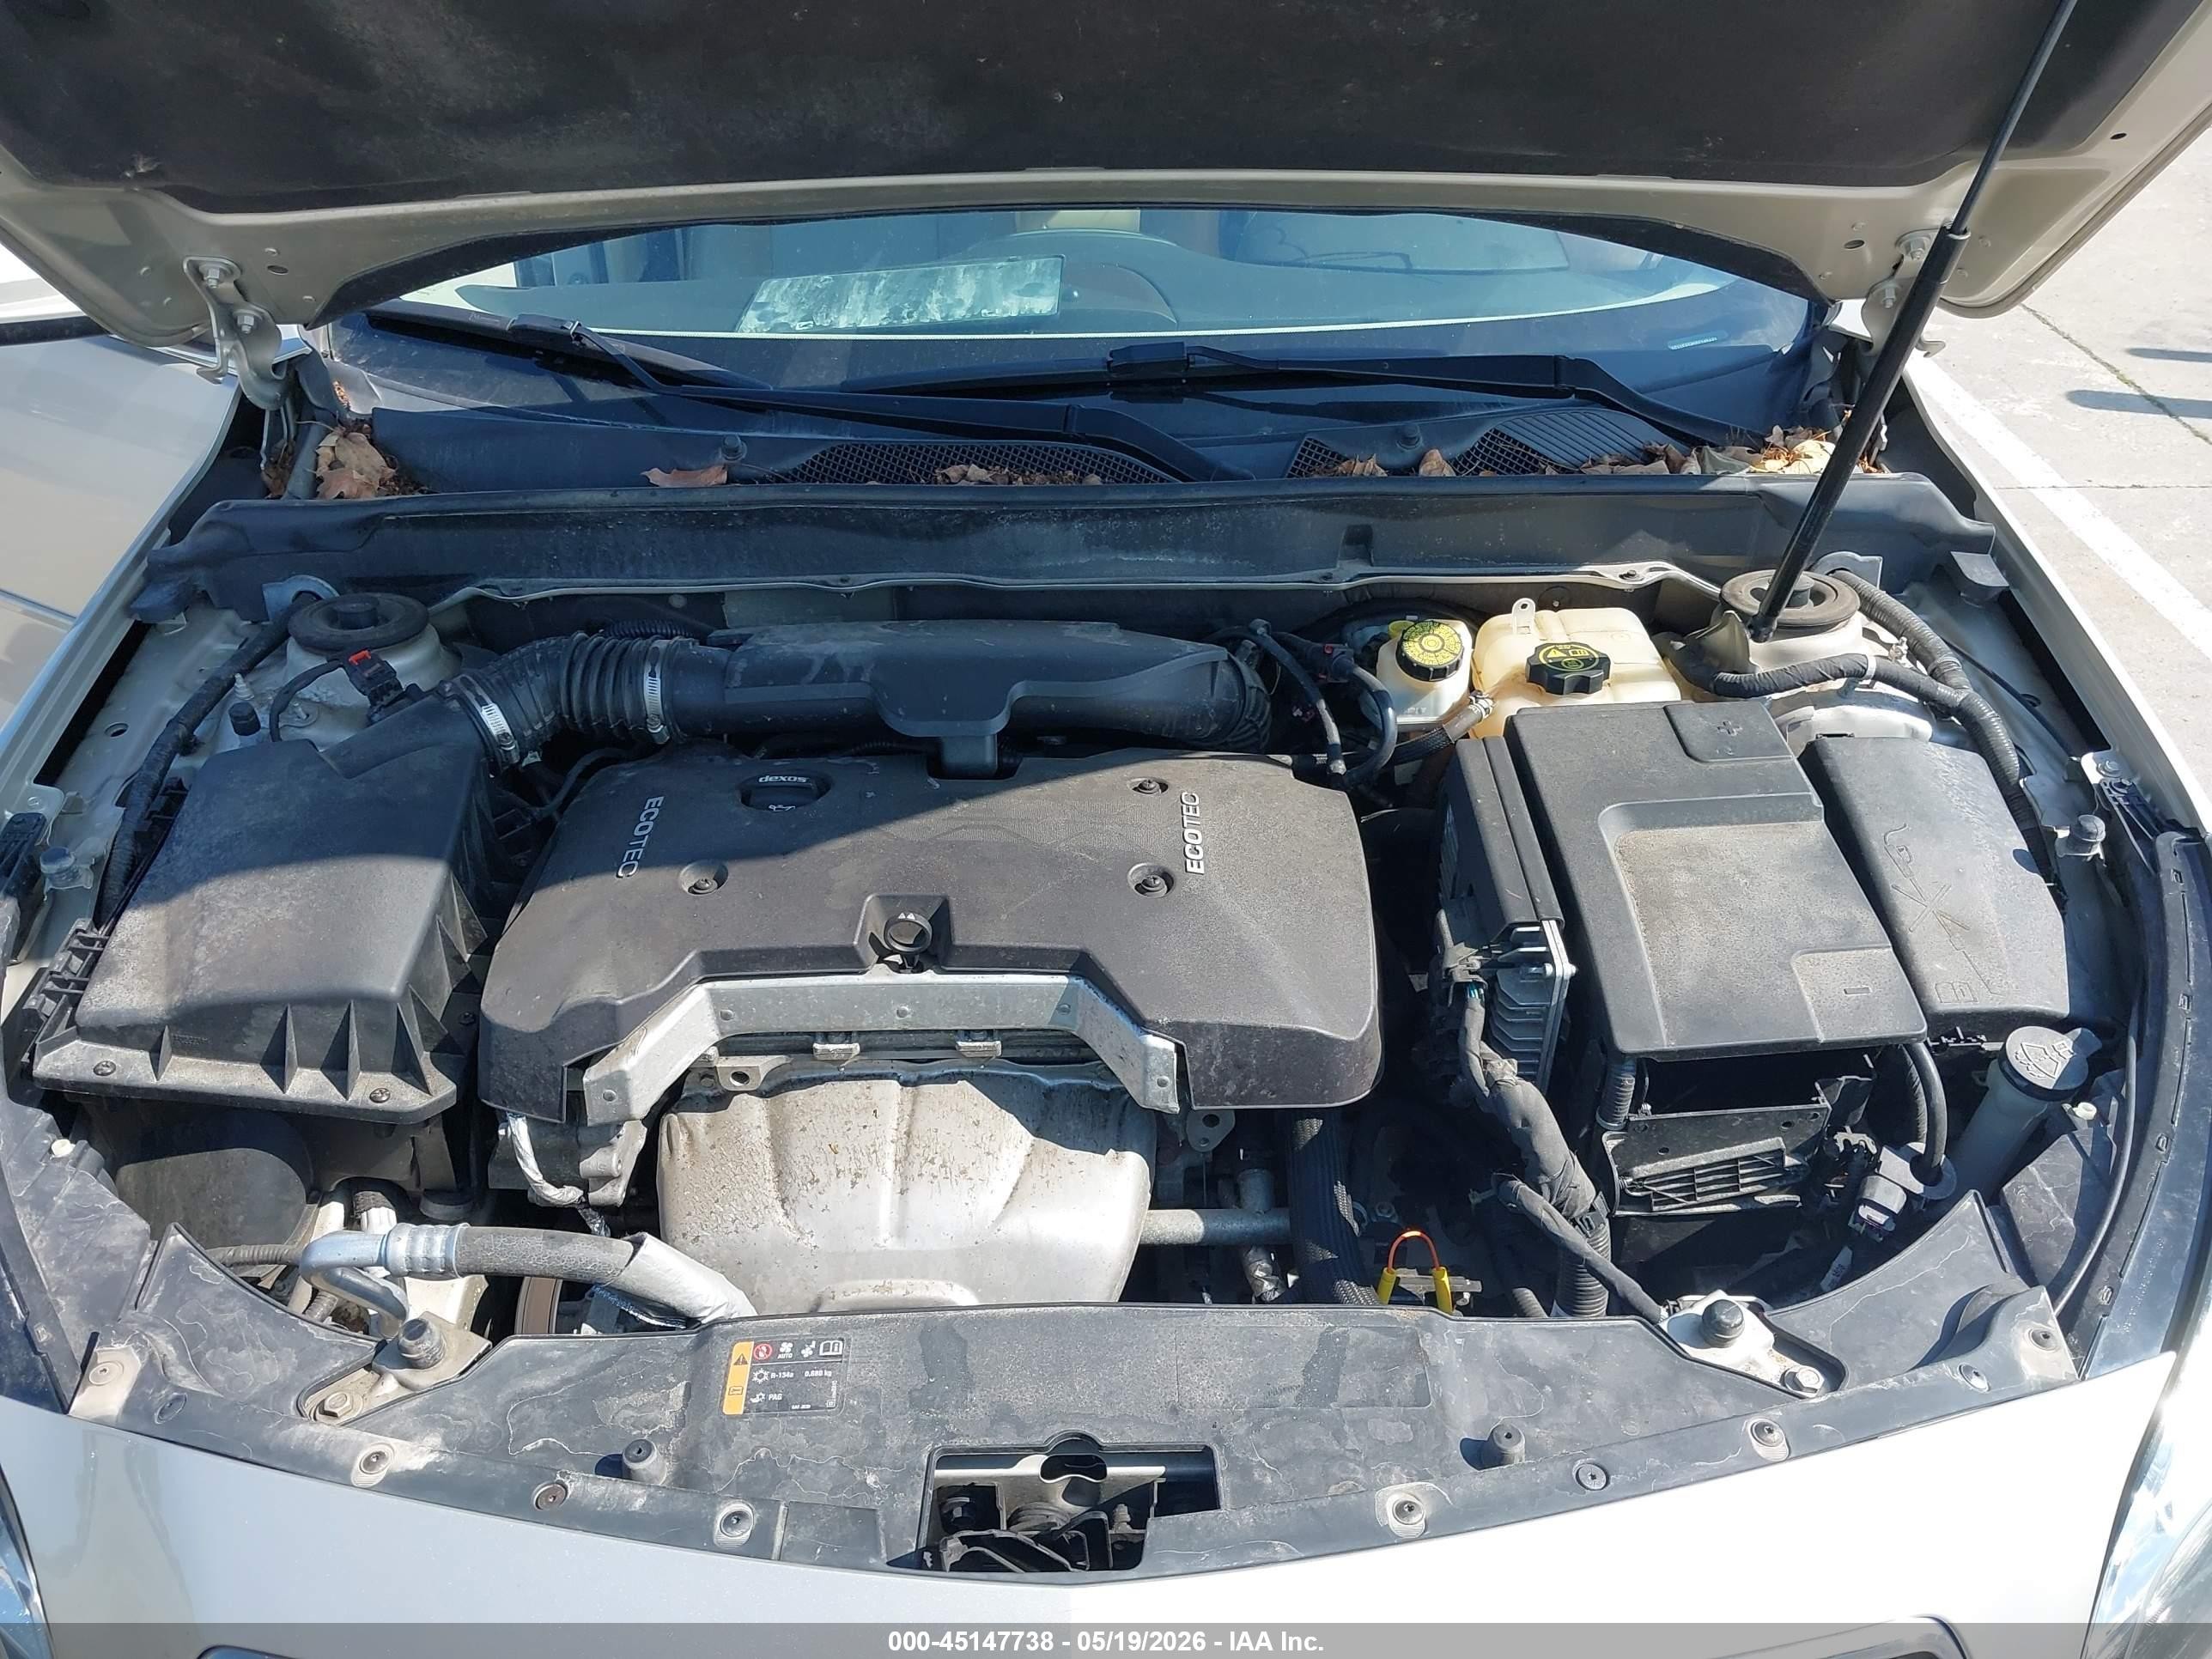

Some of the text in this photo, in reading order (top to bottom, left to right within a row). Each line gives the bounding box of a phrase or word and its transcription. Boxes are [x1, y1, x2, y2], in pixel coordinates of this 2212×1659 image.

[758, 775, 809, 783] dexos
[616, 795, 665, 878] ECOTEC
[1180, 792, 1205, 875] ECOTEC
